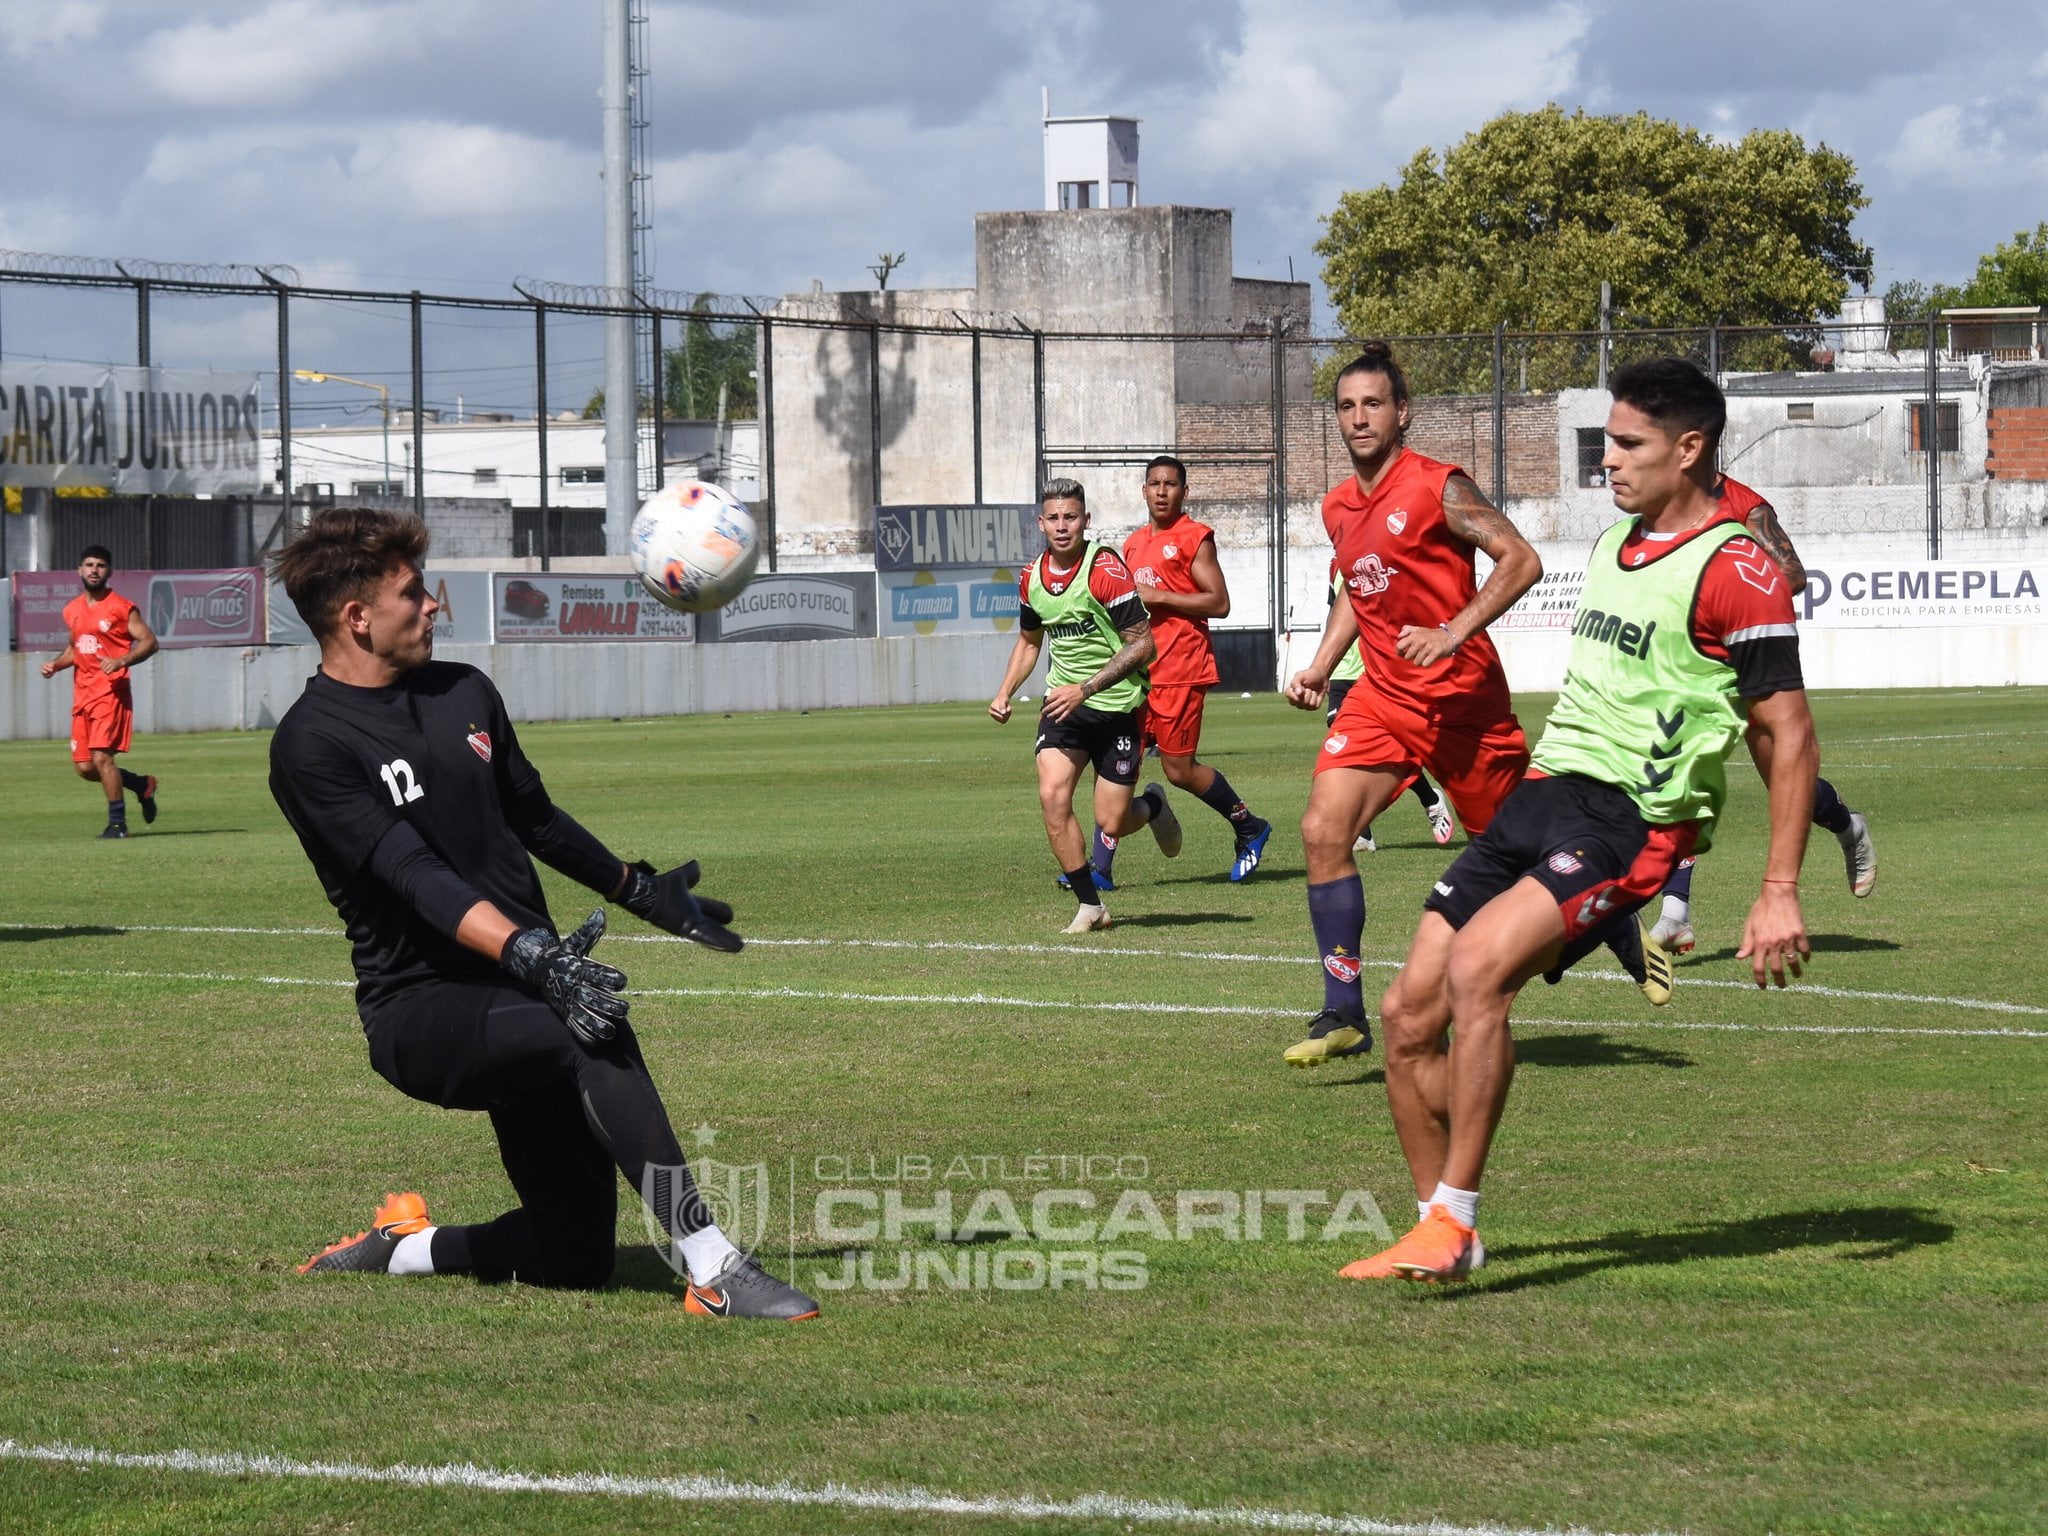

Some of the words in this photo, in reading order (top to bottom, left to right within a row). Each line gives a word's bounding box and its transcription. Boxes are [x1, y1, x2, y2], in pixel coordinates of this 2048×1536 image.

[118, 391, 258, 471] JUNIORS
[911, 510, 942, 563] LA
[946, 509, 1024, 562] NUEVA
[1536, 571, 1587, 584] GRAFI
[1841, 570, 2040, 600] CEMEPLA
[562, 584, 605, 600] Remises
[725, 592, 798, 618] SALGUERO
[801, 593, 850, 615] FUTBOL
[898, 593, 909, 615] la
[912, 596, 953, 614] rumana
[976, 590, 987, 612] la
[559, 601, 640, 635] LAVALLE
[1840, 606, 1912, 617] MEDICINA
[1919, 605, 1957, 615] PARA
[1964, 603, 2042, 615] EMPRESAS
[1571, 607, 1657, 661] ummel
[1116, 736, 1131, 751] 35
[380, 758, 425, 807] 12
